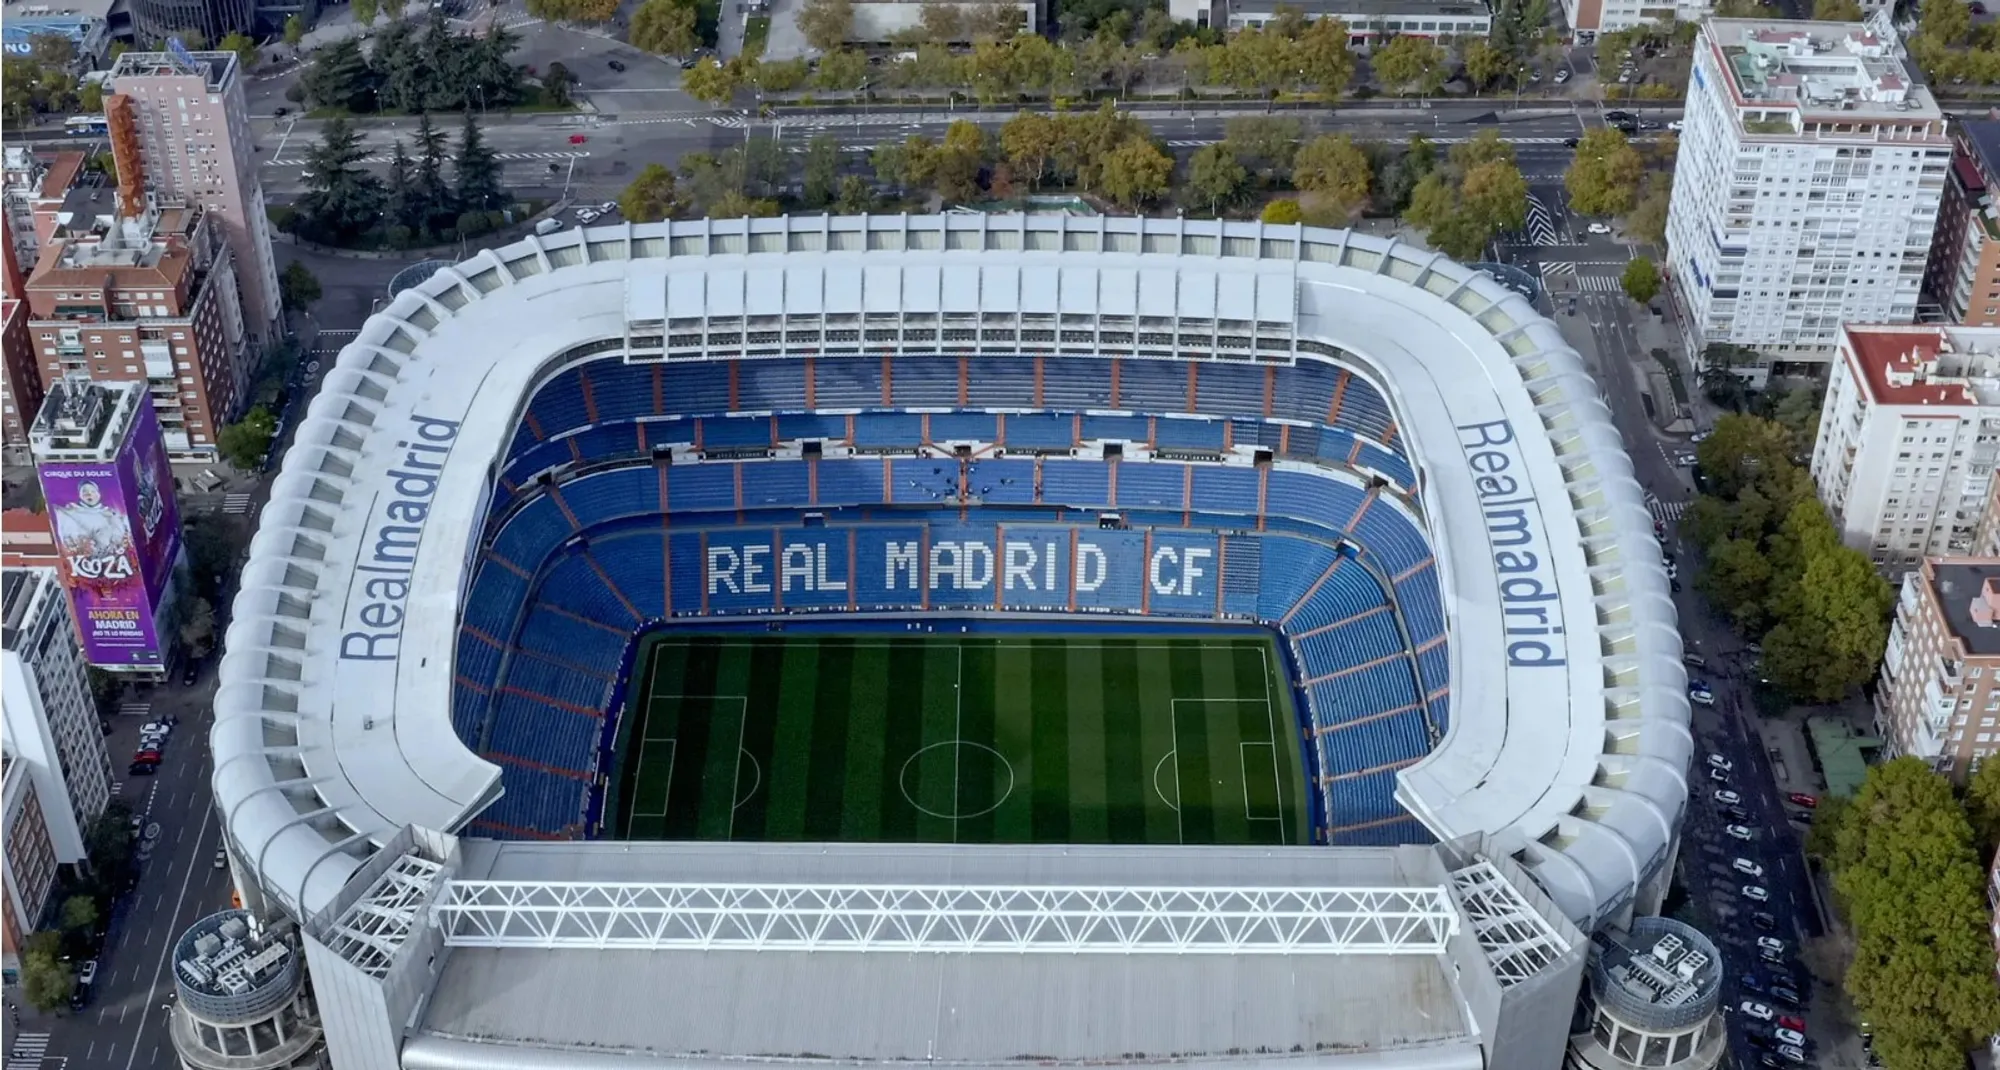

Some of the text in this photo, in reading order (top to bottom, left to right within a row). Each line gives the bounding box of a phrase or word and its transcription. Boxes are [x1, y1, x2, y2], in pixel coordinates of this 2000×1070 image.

[708, 543, 847, 594] REAL
[886, 541, 1106, 592] MADRID
[88, 611, 139, 619] AHORA EN
[95, 620, 135, 628] MADRID
